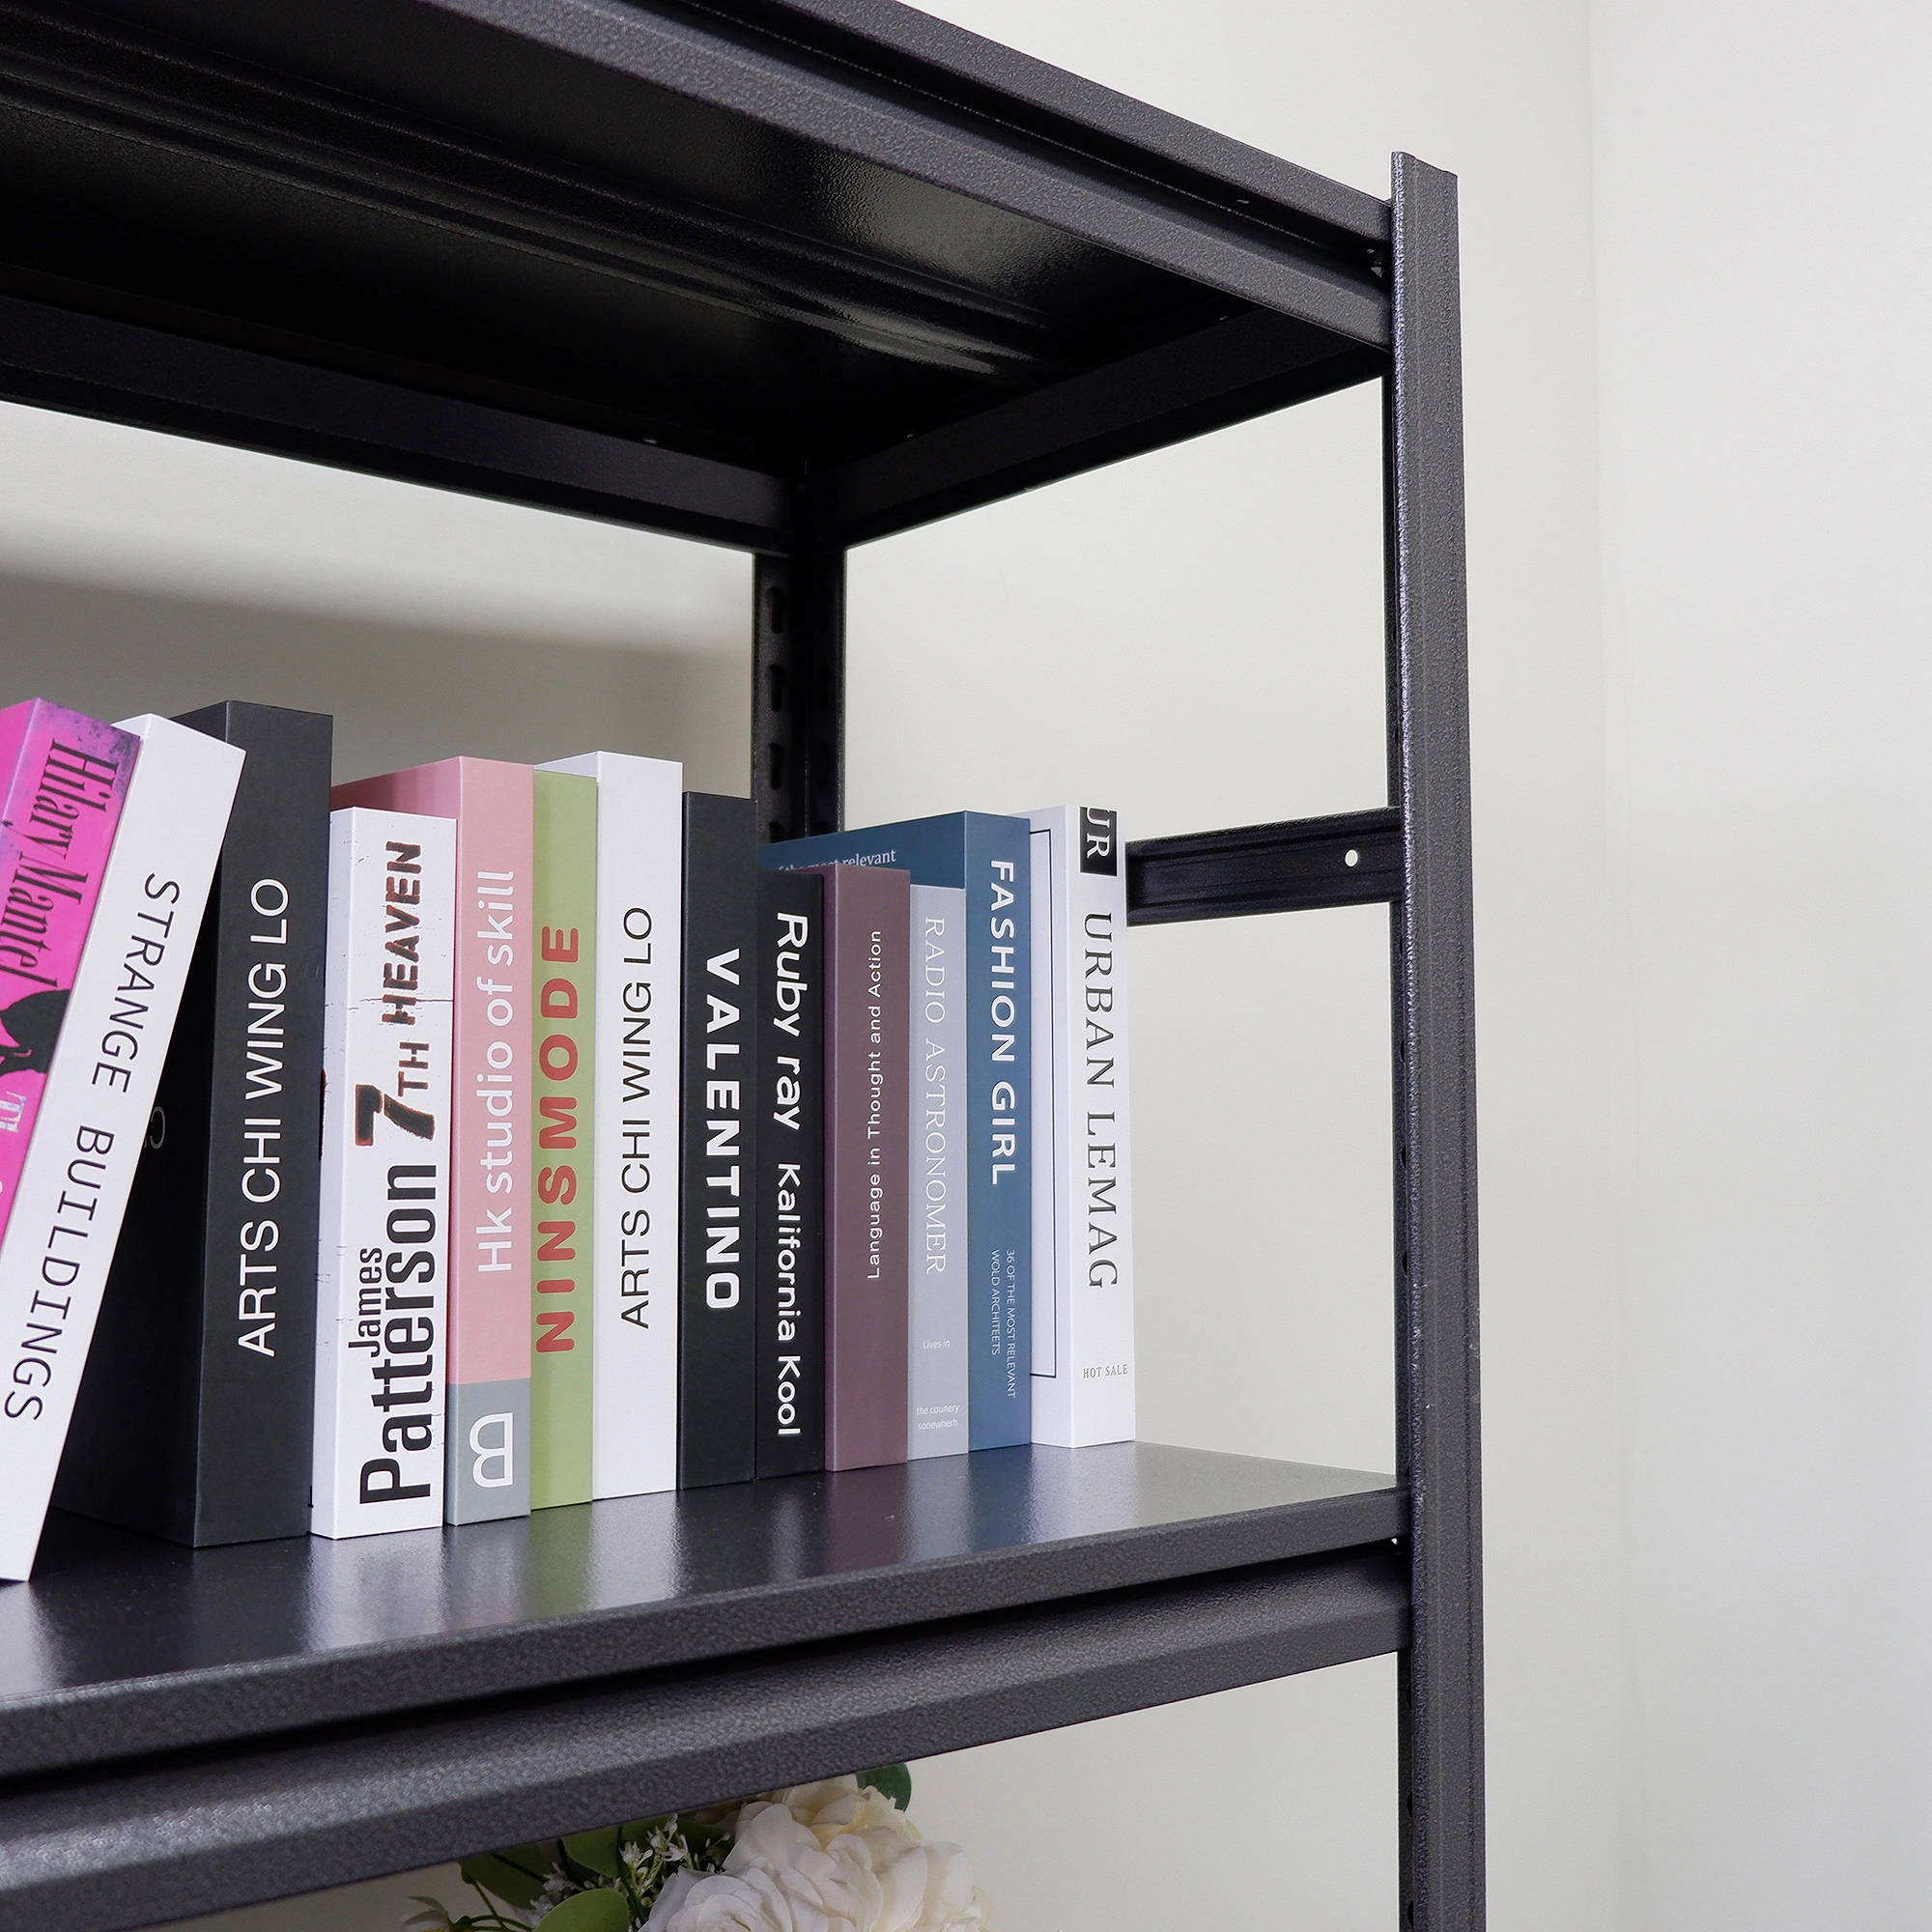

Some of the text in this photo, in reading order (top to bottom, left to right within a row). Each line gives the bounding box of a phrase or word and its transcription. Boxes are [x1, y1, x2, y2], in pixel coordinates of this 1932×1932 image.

[0, 738, 119, 987] Hilary Mantel
[381, 840, 422, 1025] HEAVEN
[990, 860, 1017, 1185] FASHION GIRL
[4, 872, 181, 1421] STRANGE BUILDINGS
[238, 877, 290, 1357] ARTS CHI WING LO
[476, 870, 515, 1272] Hk studio of skill
[536, 925, 579, 1353] NINSMODE
[620, 907, 653, 1329] ARTS CHI WING LO
[706, 948, 741, 1309] VALENTINO
[773, 912, 809, 1435] Ruby ray Kalifornia Kool
[867, 930, 884, 1279] Language in Thought and Action
[924, 917, 948, 1275] RADIO ASTRONOMER
[1084, 911, 1119, 1290] URBAN LEMAG
[348, 1164, 438, 1505] James Patterson
[916, 1406, 928, 1415] the
[923, 1339, 951, 1350] Lives in
[991, 1249, 1001, 1287] WOLD
[1006, 1249, 1016, 1399] 36 OF THE MOST RELEVANT
[1083, 1363, 1128, 1378] HOT SALE
